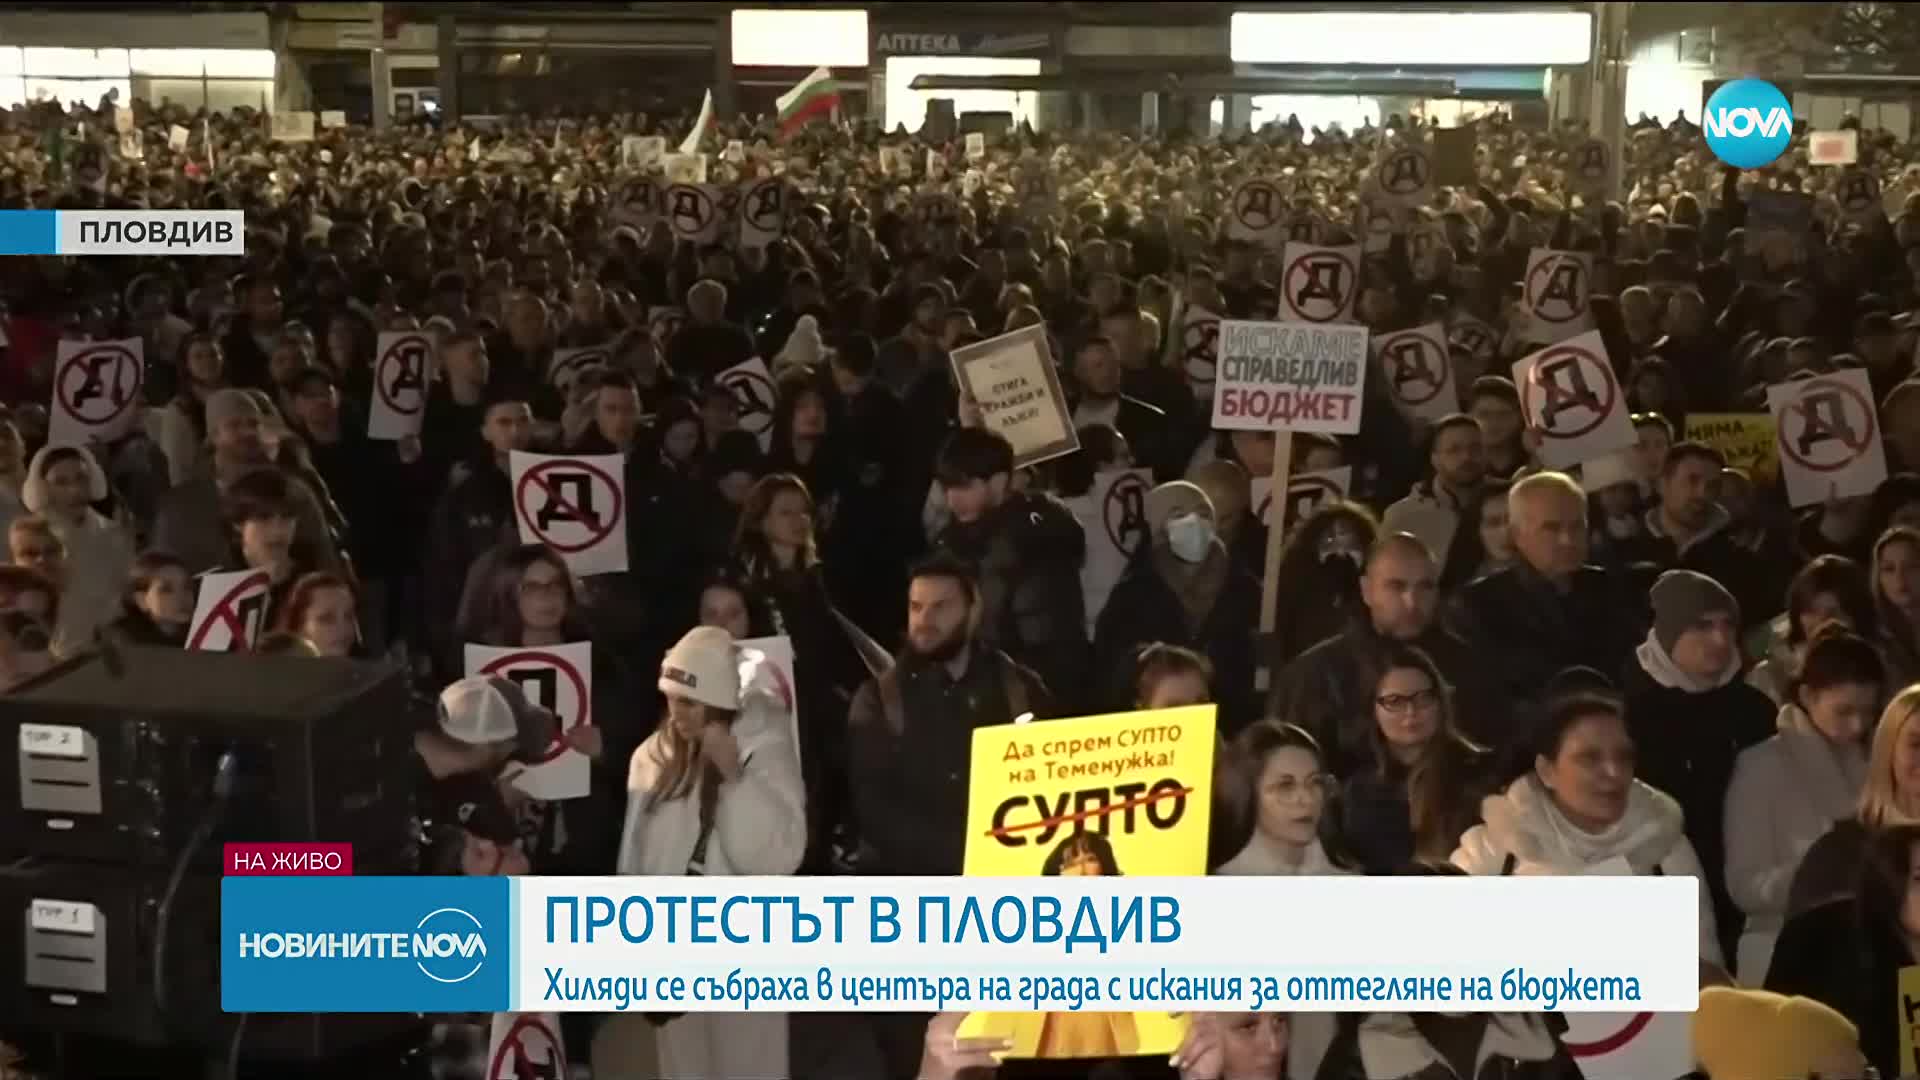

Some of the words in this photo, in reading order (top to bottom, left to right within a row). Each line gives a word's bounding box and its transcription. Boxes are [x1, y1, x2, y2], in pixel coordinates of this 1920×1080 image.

[877, 32, 960, 51] АПТЕКА
[673, 190, 703, 226] Д
[1242, 187, 1277, 224] Д
[1297, 261, 1342, 308] Д
[1537, 264, 1581, 310] Д
[1224, 325, 1363, 360] ИСКАМЕ
[392, 347, 425, 398] Д
[1222, 355, 1359, 390] СПРАВЕДЛИВ
[1394, 342, 1436, 392] Д
[1220, 388, 1357, 424] БЮДЖЕТ
[1541, 356, 1601, 428] Д
[1797, 391, 1857, 457] Д
[537, 472, 602, 532] Д
[1002, 740, 1035, 762] Да
[1041, 735, 1112, 758] спрем
[1117, 724, 1182, 748] СУПТО
[1009, 767, 1036, 784] на
[1044, 749, 1176, 780] Теменужка!
[991, 777, 1187, 848] СУПТО
